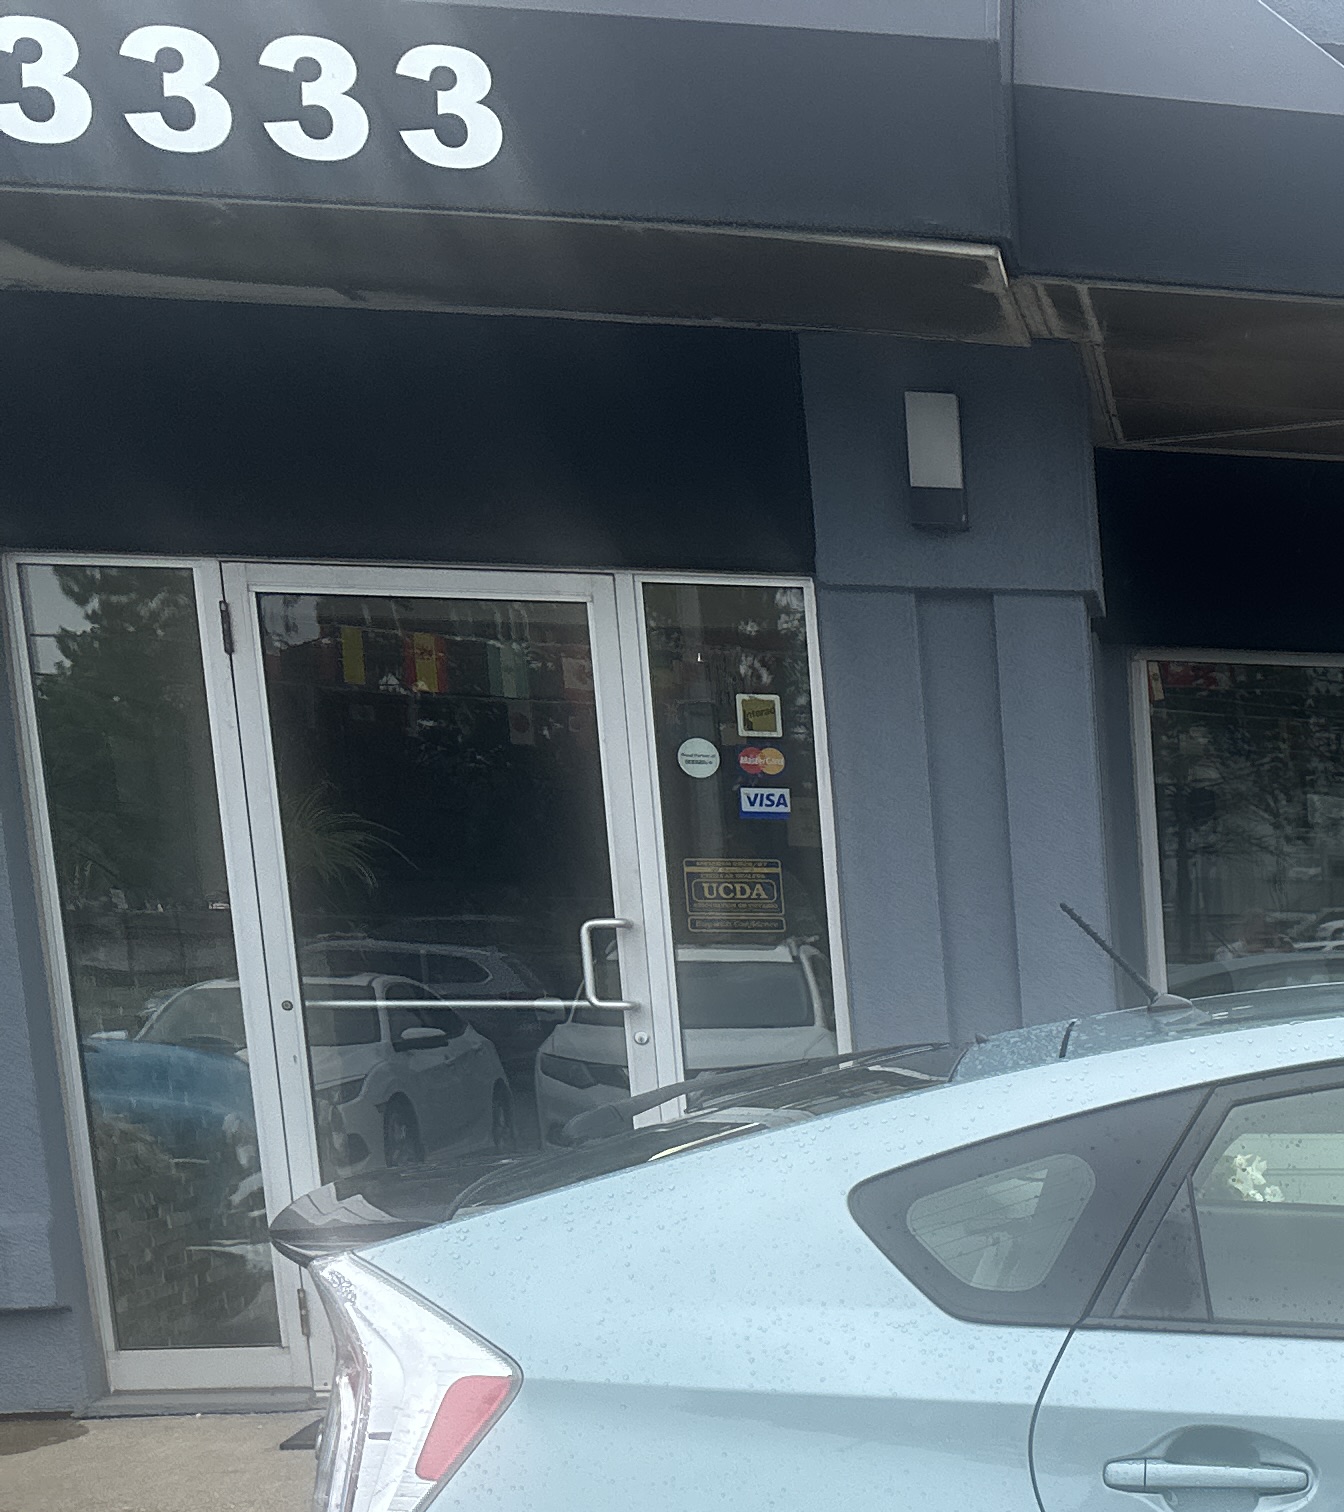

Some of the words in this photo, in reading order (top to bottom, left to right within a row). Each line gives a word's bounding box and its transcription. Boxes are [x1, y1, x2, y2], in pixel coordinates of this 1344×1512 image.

[0, 14, 504, 170] 3333
[746, 793, 788, 808] VISA
[702, 882, 769, 899] UCDA
